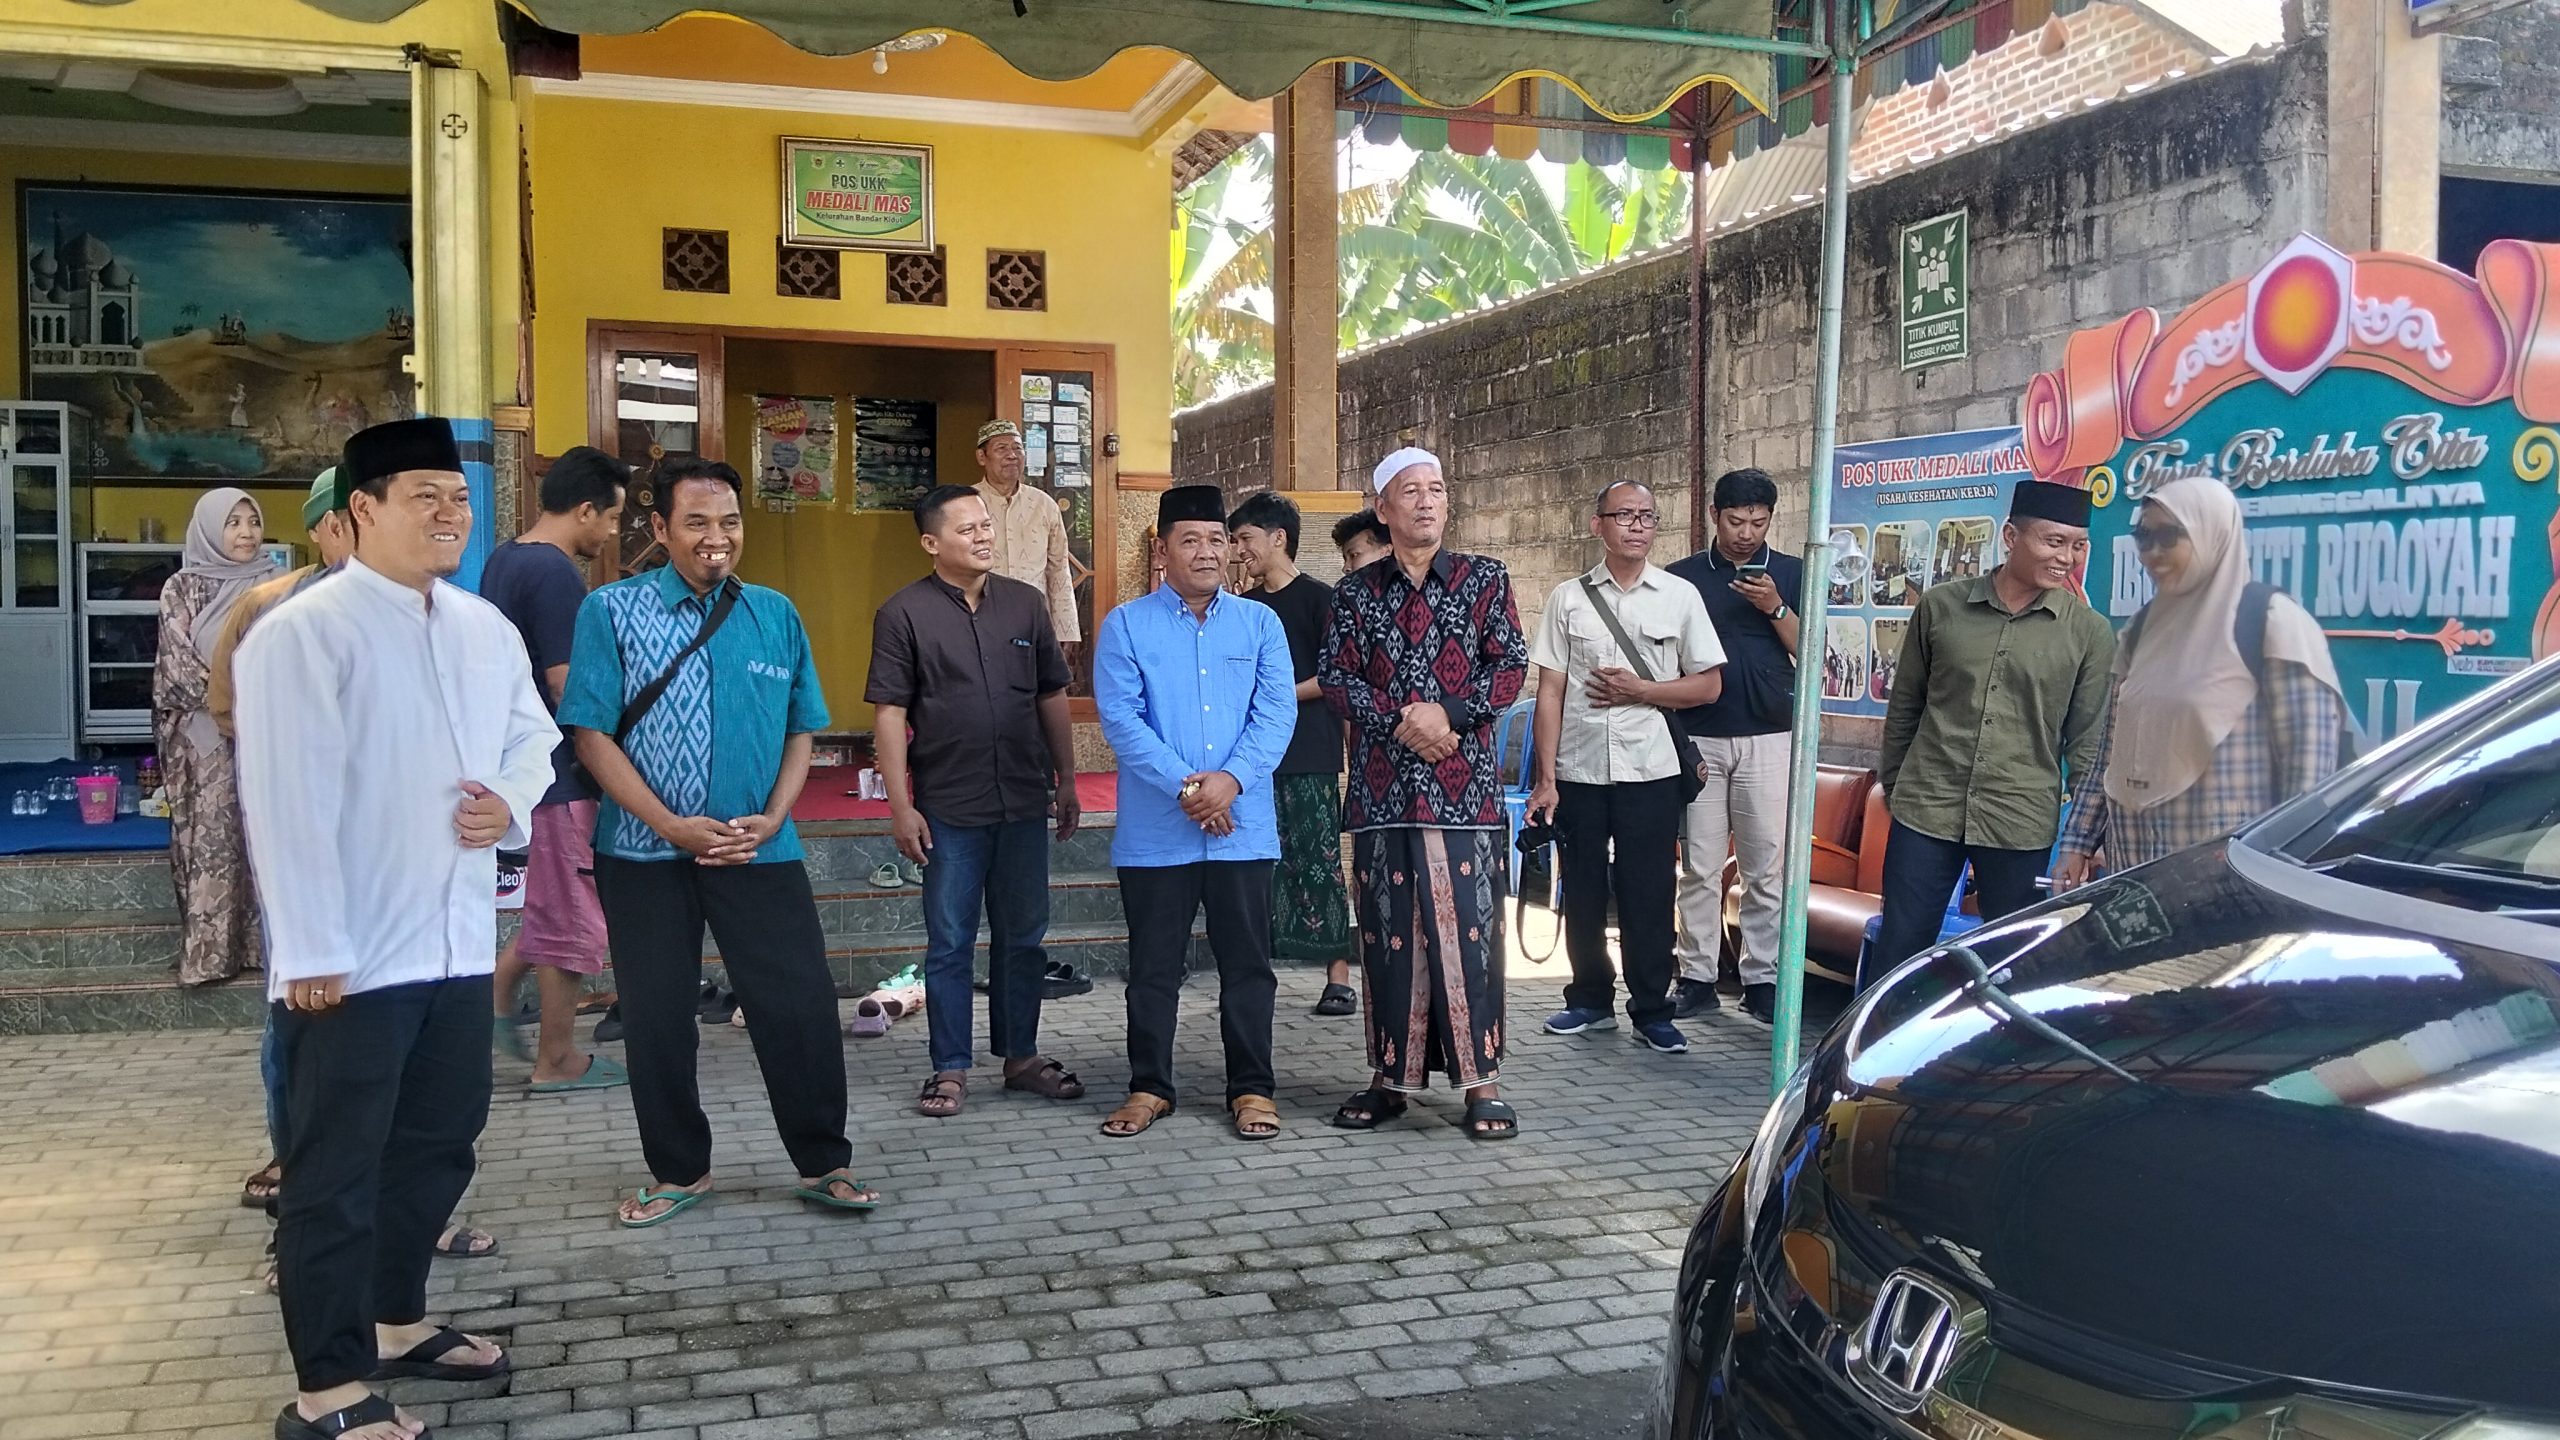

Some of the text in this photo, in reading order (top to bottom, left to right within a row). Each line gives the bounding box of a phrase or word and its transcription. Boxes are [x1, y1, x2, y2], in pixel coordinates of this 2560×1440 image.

[831, 174, 887, 191] POS UKK
[806, 191, 911, 213] MEDALI MAS
[816, 212, 854, 221] Kelurahan
[856, 214, 881, 222] Bandar
[1908, 319, 1959, 342] TITIK KUMPUL
[1909, 341, 1960, 360] ASSEMBLY POINT
[876, 418, 913, 427] GERMAS
[2216, 427, 2379, 489] Berduka
[2382, 412, 2489, 480] Cita
[1842, 447, 2030, 487] POS UKK MEDALI MA
[1876, 484, 1998, 506] (USAHA KESEHATAN KERJA)
[2237, 482, 2485, 517] ENINGGALNYA
[2243, 526, 2306, 608] ITI
[2315, 516, 2516, 618] RUQOYAH
